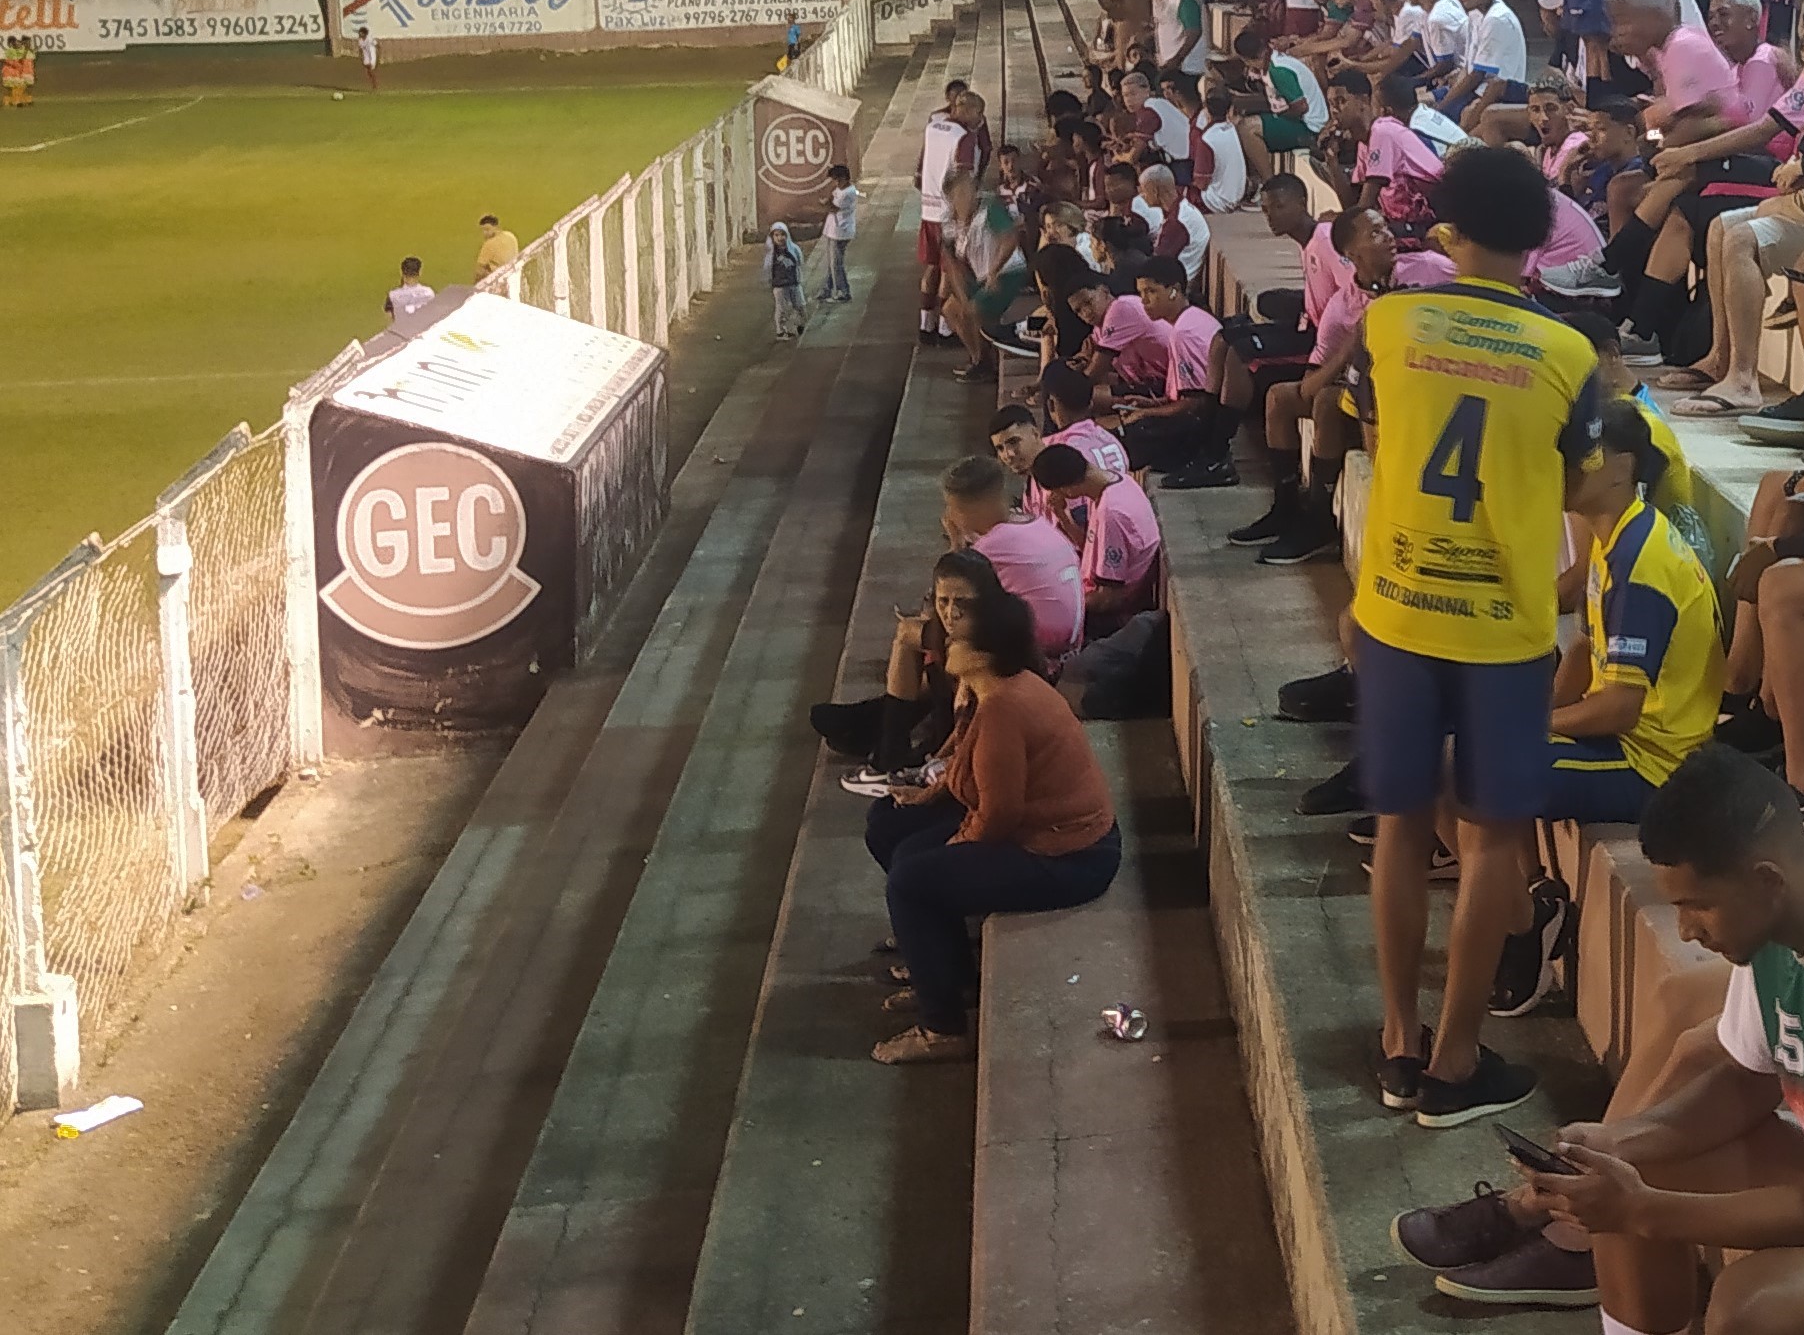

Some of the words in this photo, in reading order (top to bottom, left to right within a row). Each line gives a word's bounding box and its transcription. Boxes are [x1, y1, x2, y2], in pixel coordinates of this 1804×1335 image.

[154, 16, 198, 37] 1583
[206, 17, 268, 36] 99602
[273, 14, 321, 35] 3243
[431, 6, 539, 20] ENGENHARIA
[768, 129, 827, 165] GEC
[1420, 394, 1488, 524] 4
[353, 483, 507, 579] GEC
[1402, 585, 1477, 618] BANANAL
